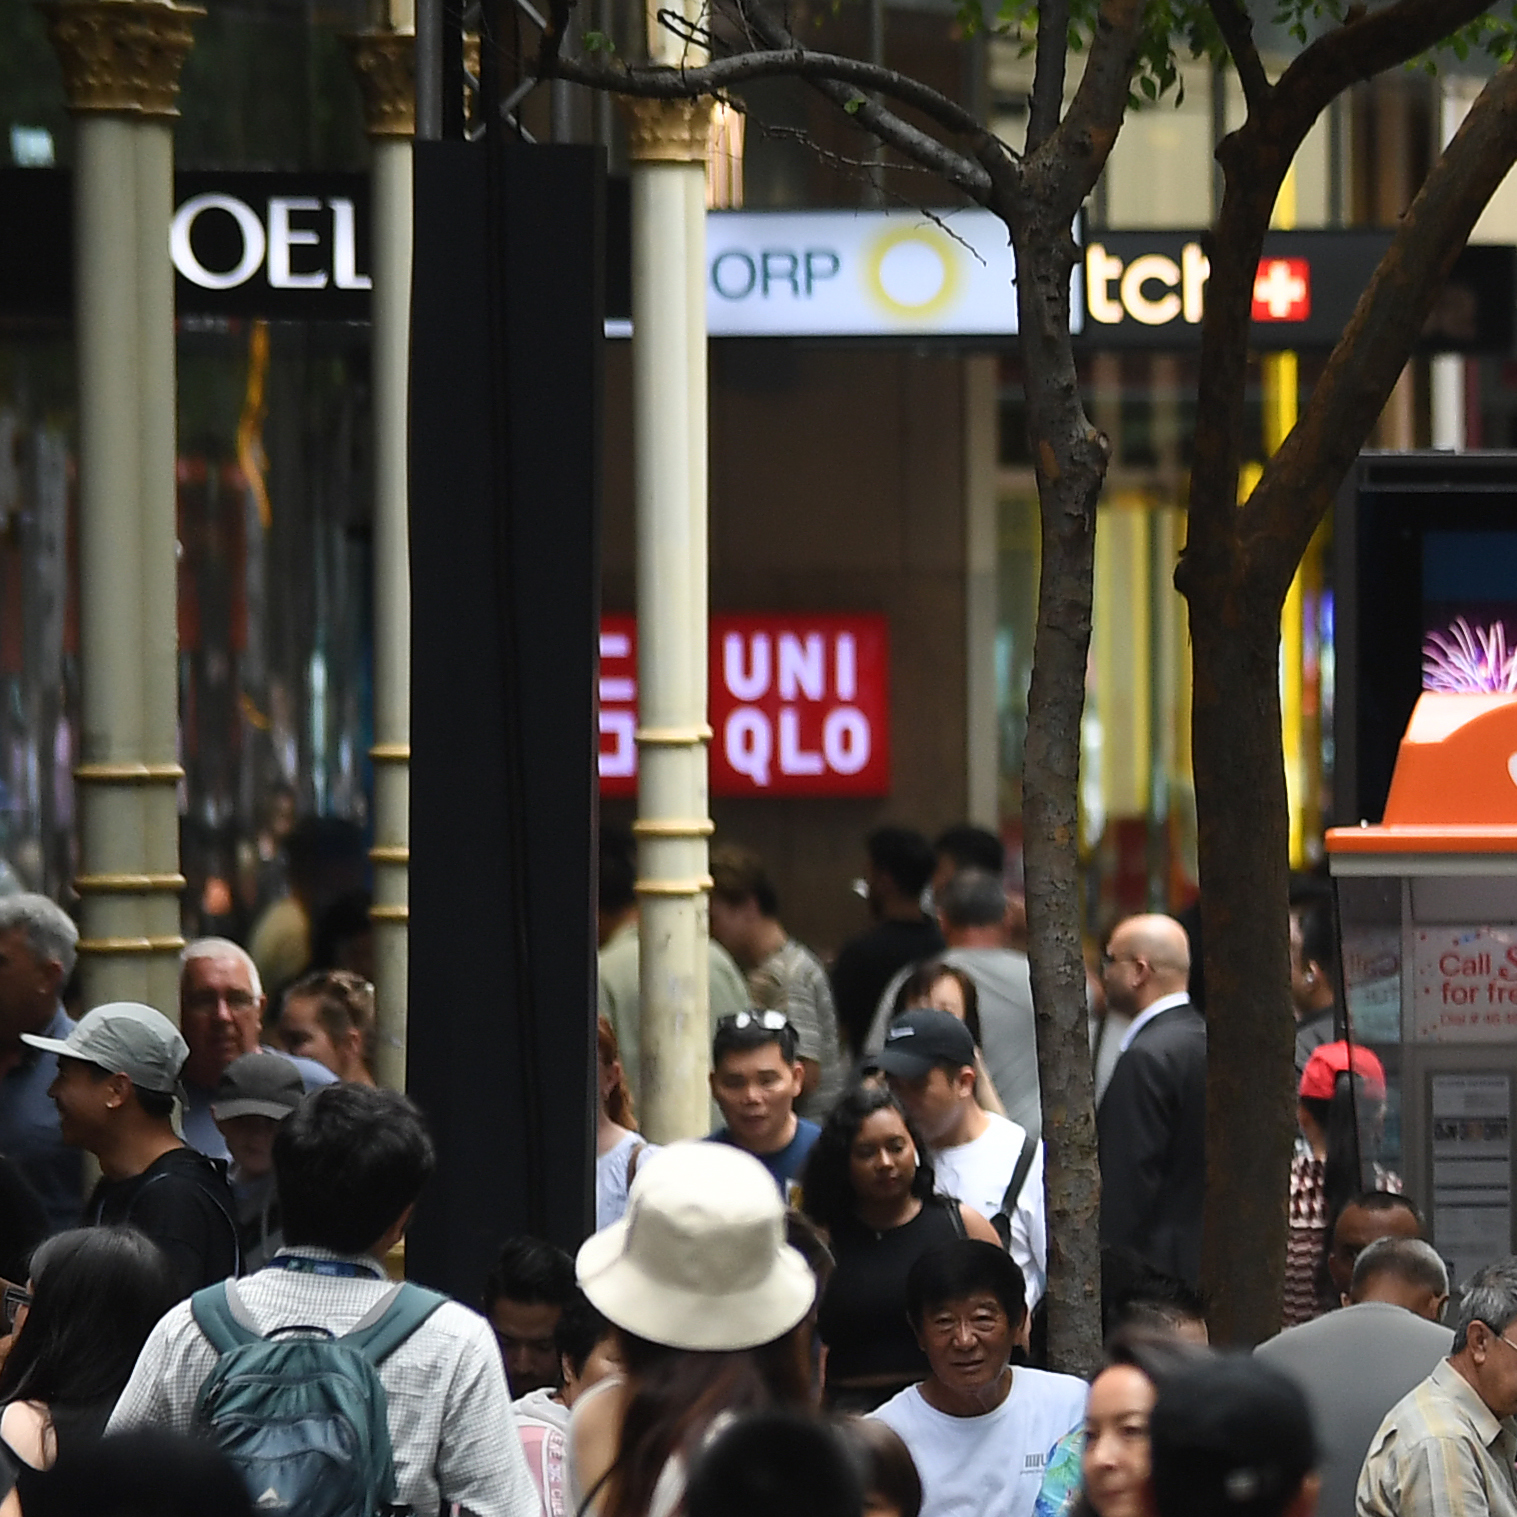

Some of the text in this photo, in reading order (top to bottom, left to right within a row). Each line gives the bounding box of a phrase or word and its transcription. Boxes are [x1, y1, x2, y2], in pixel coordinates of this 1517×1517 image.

[169, 192, 373, 290] OEL
[711, 249, 840, 300] ORP
[724, 632, 857, 702] UNI
[725, 708, 871, 786] QLO
[1439, 952, 1491, 978] Call
[1442, 982, 1482, 1005] for
